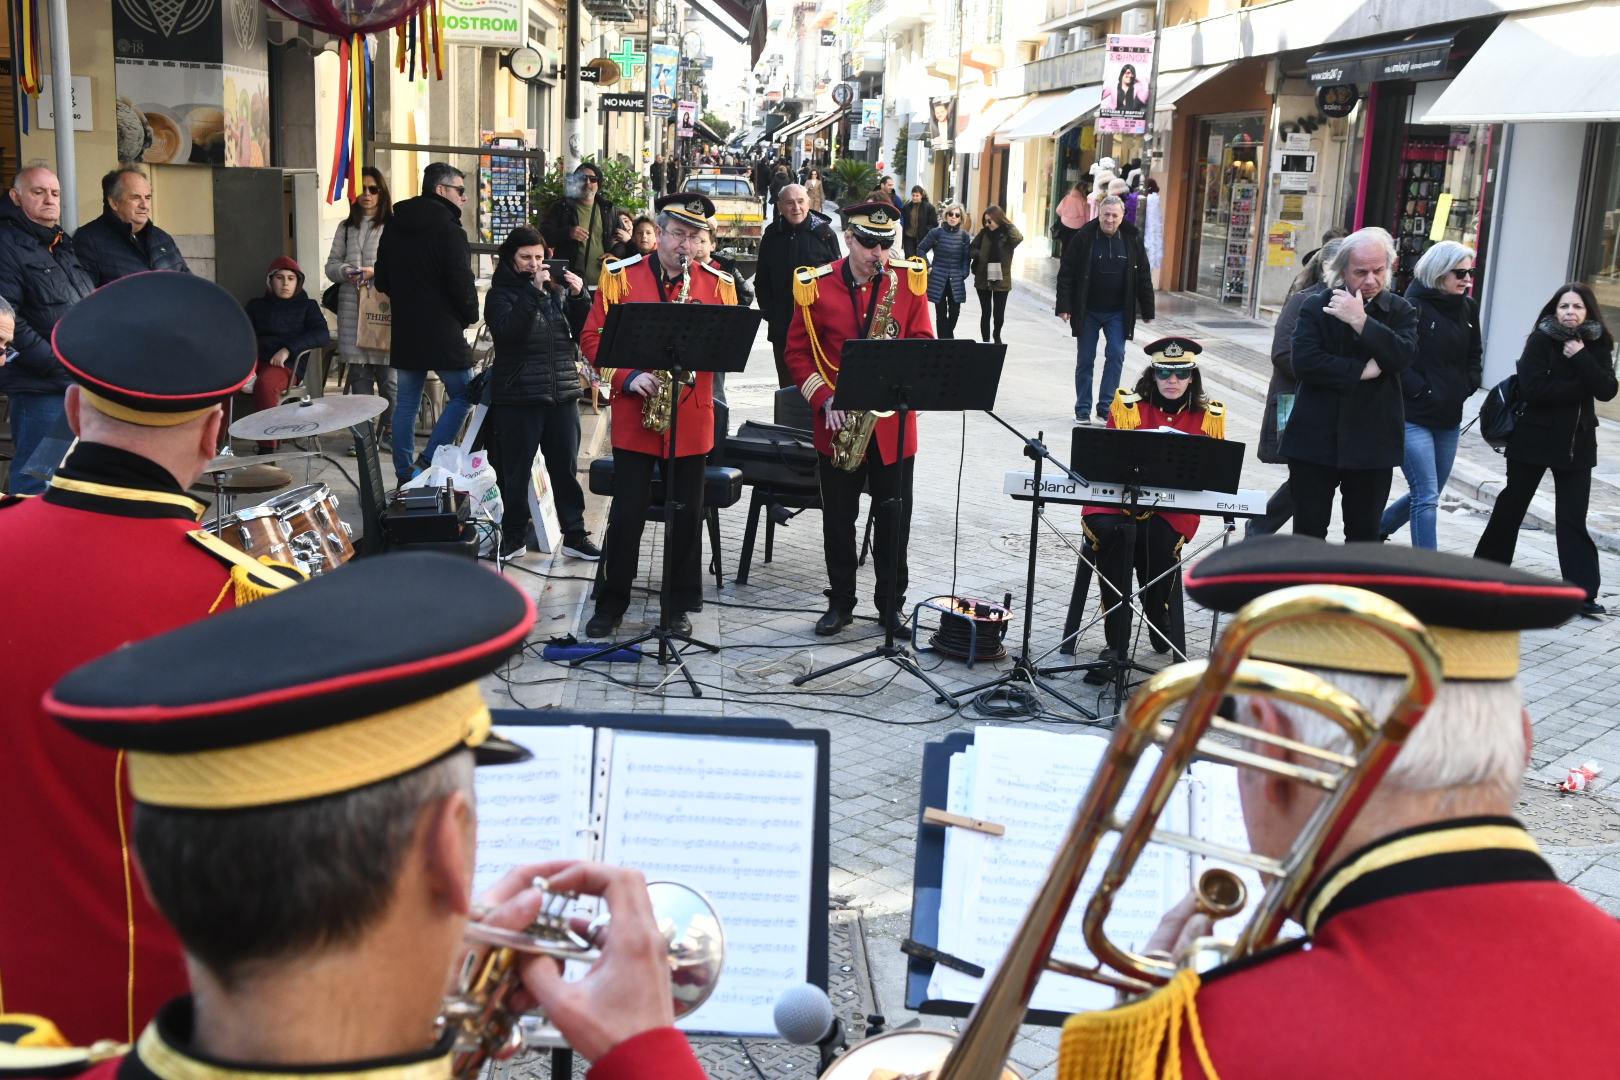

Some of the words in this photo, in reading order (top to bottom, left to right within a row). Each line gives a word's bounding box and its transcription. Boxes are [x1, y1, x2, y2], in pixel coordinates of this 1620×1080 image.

[1110, 53, 1148, 62] ΣΦΗΝΟΣ
[604, 98, 618, 106] NO
[619, 99, 644, 108] NAME
[1217, 502, 1249, 511] EM-15
